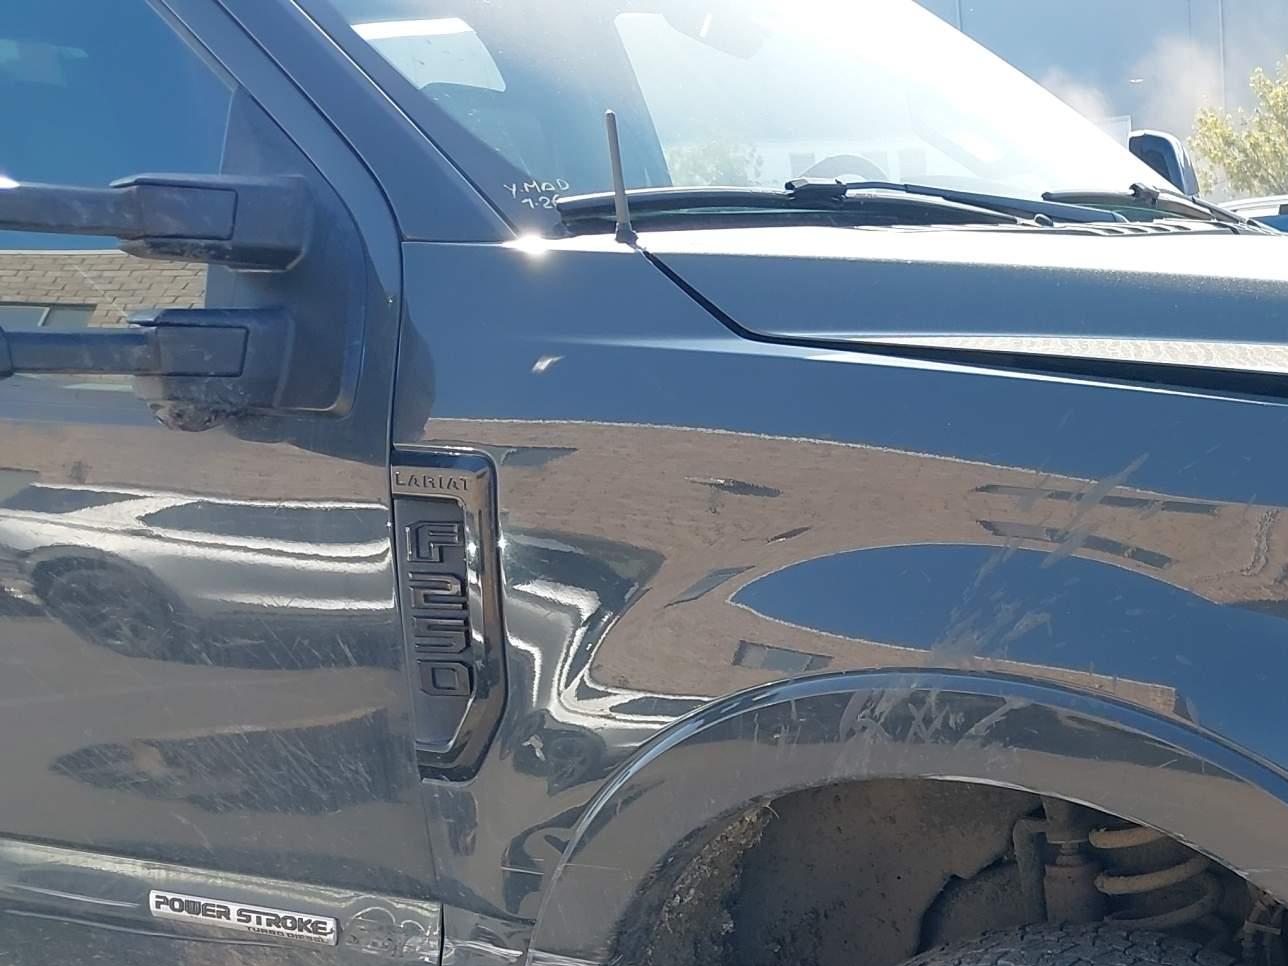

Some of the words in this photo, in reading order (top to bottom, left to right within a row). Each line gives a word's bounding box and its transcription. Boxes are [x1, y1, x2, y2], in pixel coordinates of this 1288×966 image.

[395, 471, 471, 491] LARIAT
[154, 894, 231, 921] POWER
[237, 907, 334, 938] STROKE
